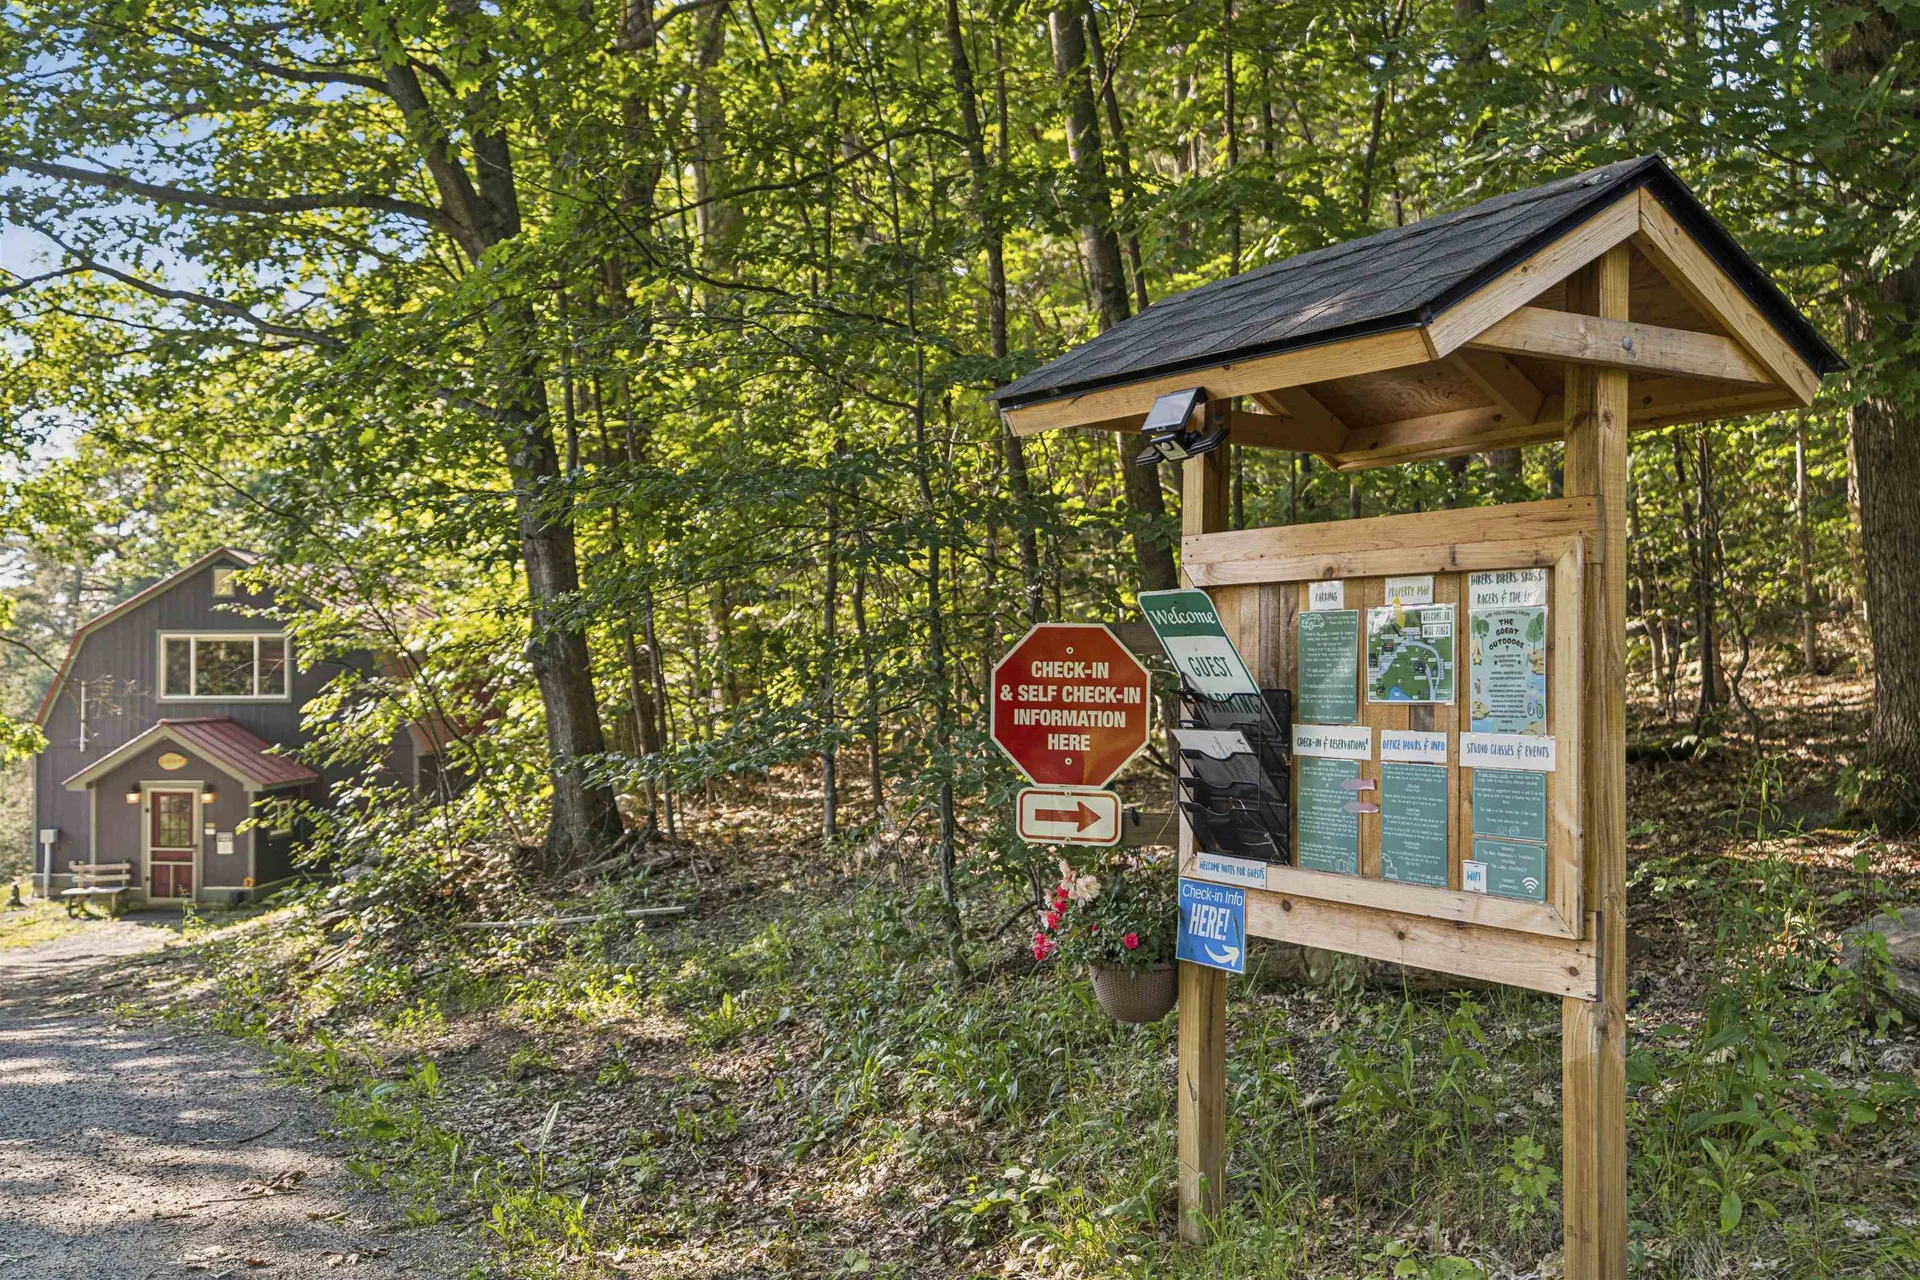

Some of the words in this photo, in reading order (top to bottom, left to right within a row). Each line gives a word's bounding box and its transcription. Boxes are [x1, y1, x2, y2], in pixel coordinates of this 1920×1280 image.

[1315, 591, 1337, 602] PARKING
[1389, 586, 1414, 598] PROPERTY
[1417, 585, 1430, 595] MAP
[1477, 593, 1498, 604] RACERS
[1509, 591, 1520, 603] THE
[1149, 608, 1217, 626] Welcome
[1496, 627, 1519, 636] GREAT
[1488, 637, 1524, 650] OUTDOORS
[1031, 661, 1109, 679] CHECK-IN
[1188, 656, 1234, 678] GUEST
[1000, 685, 1013, 701] &
[1017, 685, 1057, 702] SELF
[1058, 686, 1141, 704] CHECK-IN
[1013, 709, 1126, 728] INFORMATION
[1047, 734, 1091, 751] HERE
[1297, 736, 1321, 748] CHECK-IN
[1382, 739, 1400, 750] OFFICE
[1403, 740, 1421, 751] HOURS
[1431, 740, 1445, 752] INFO
[1467, 742, 1488, 754] STUDIO
[1490, 743, 1514, 756] CLASSES
[1525, 745, 1549, 758] EVENTS
[1199, 860, 1220, 873] WELCOME
[1236, 866, 1245, 876] FOR
[1247, 868, 1264, 880] GUESTS
[1467, 870, 1481, 882] WIFI
[1182, 884, 1223, 903] Check-in
[1225, 890, 1243, 906] Info
[1188, 903, 1230, 941] HERE!
